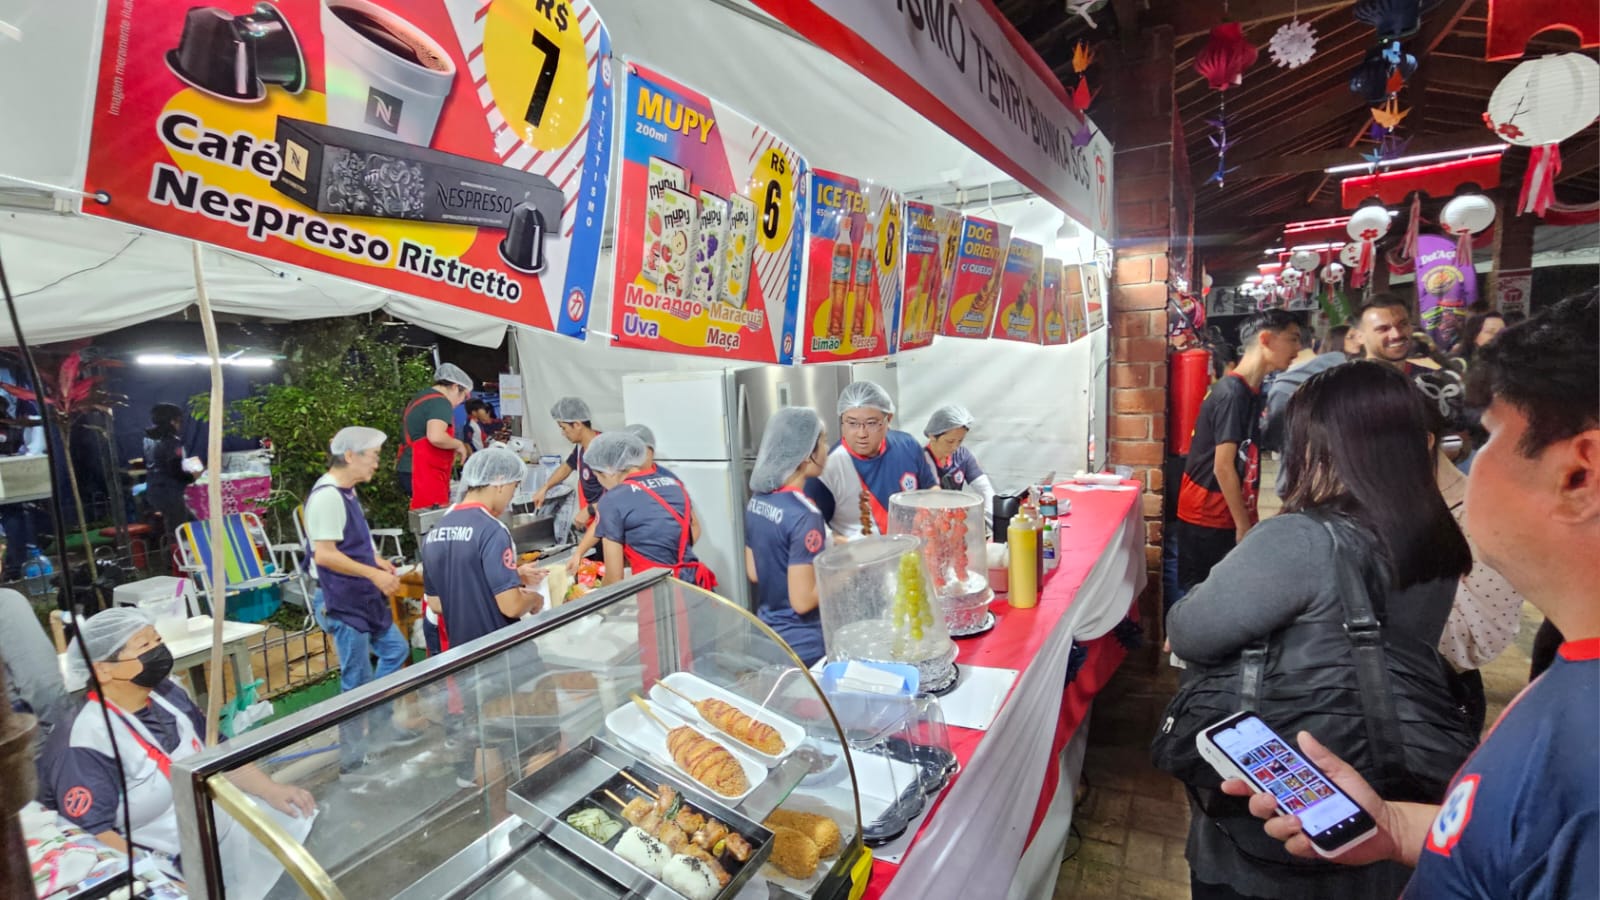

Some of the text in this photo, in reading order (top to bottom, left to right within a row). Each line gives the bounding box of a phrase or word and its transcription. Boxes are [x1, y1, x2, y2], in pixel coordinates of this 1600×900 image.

[523, 28, 561, 128] 7
[636, 86, 716, 144] MUPY
[969, 27, 1028, 135] TENRI
[1026, 96, 1072, 176] BUNKA
[161, 114, 279, 177] Café
[635, 121, 668, 143] 200ml
[770, 152, 785, 175] R$
[437, 181, 513, 214] NESPRESSO
[763, 179, 782, 240] 6
[816, 183, 871, 216] ICE TEA
[154, 167, 521, 301] Nespresso Ristretto
[885, 221, 895, 266] 8
[967, 225, 993, 242] DOG
[626, 285, 703, 319] Morango
[624, 315, 659, 337] Uva
[812, 335, 840, 351] Limão
